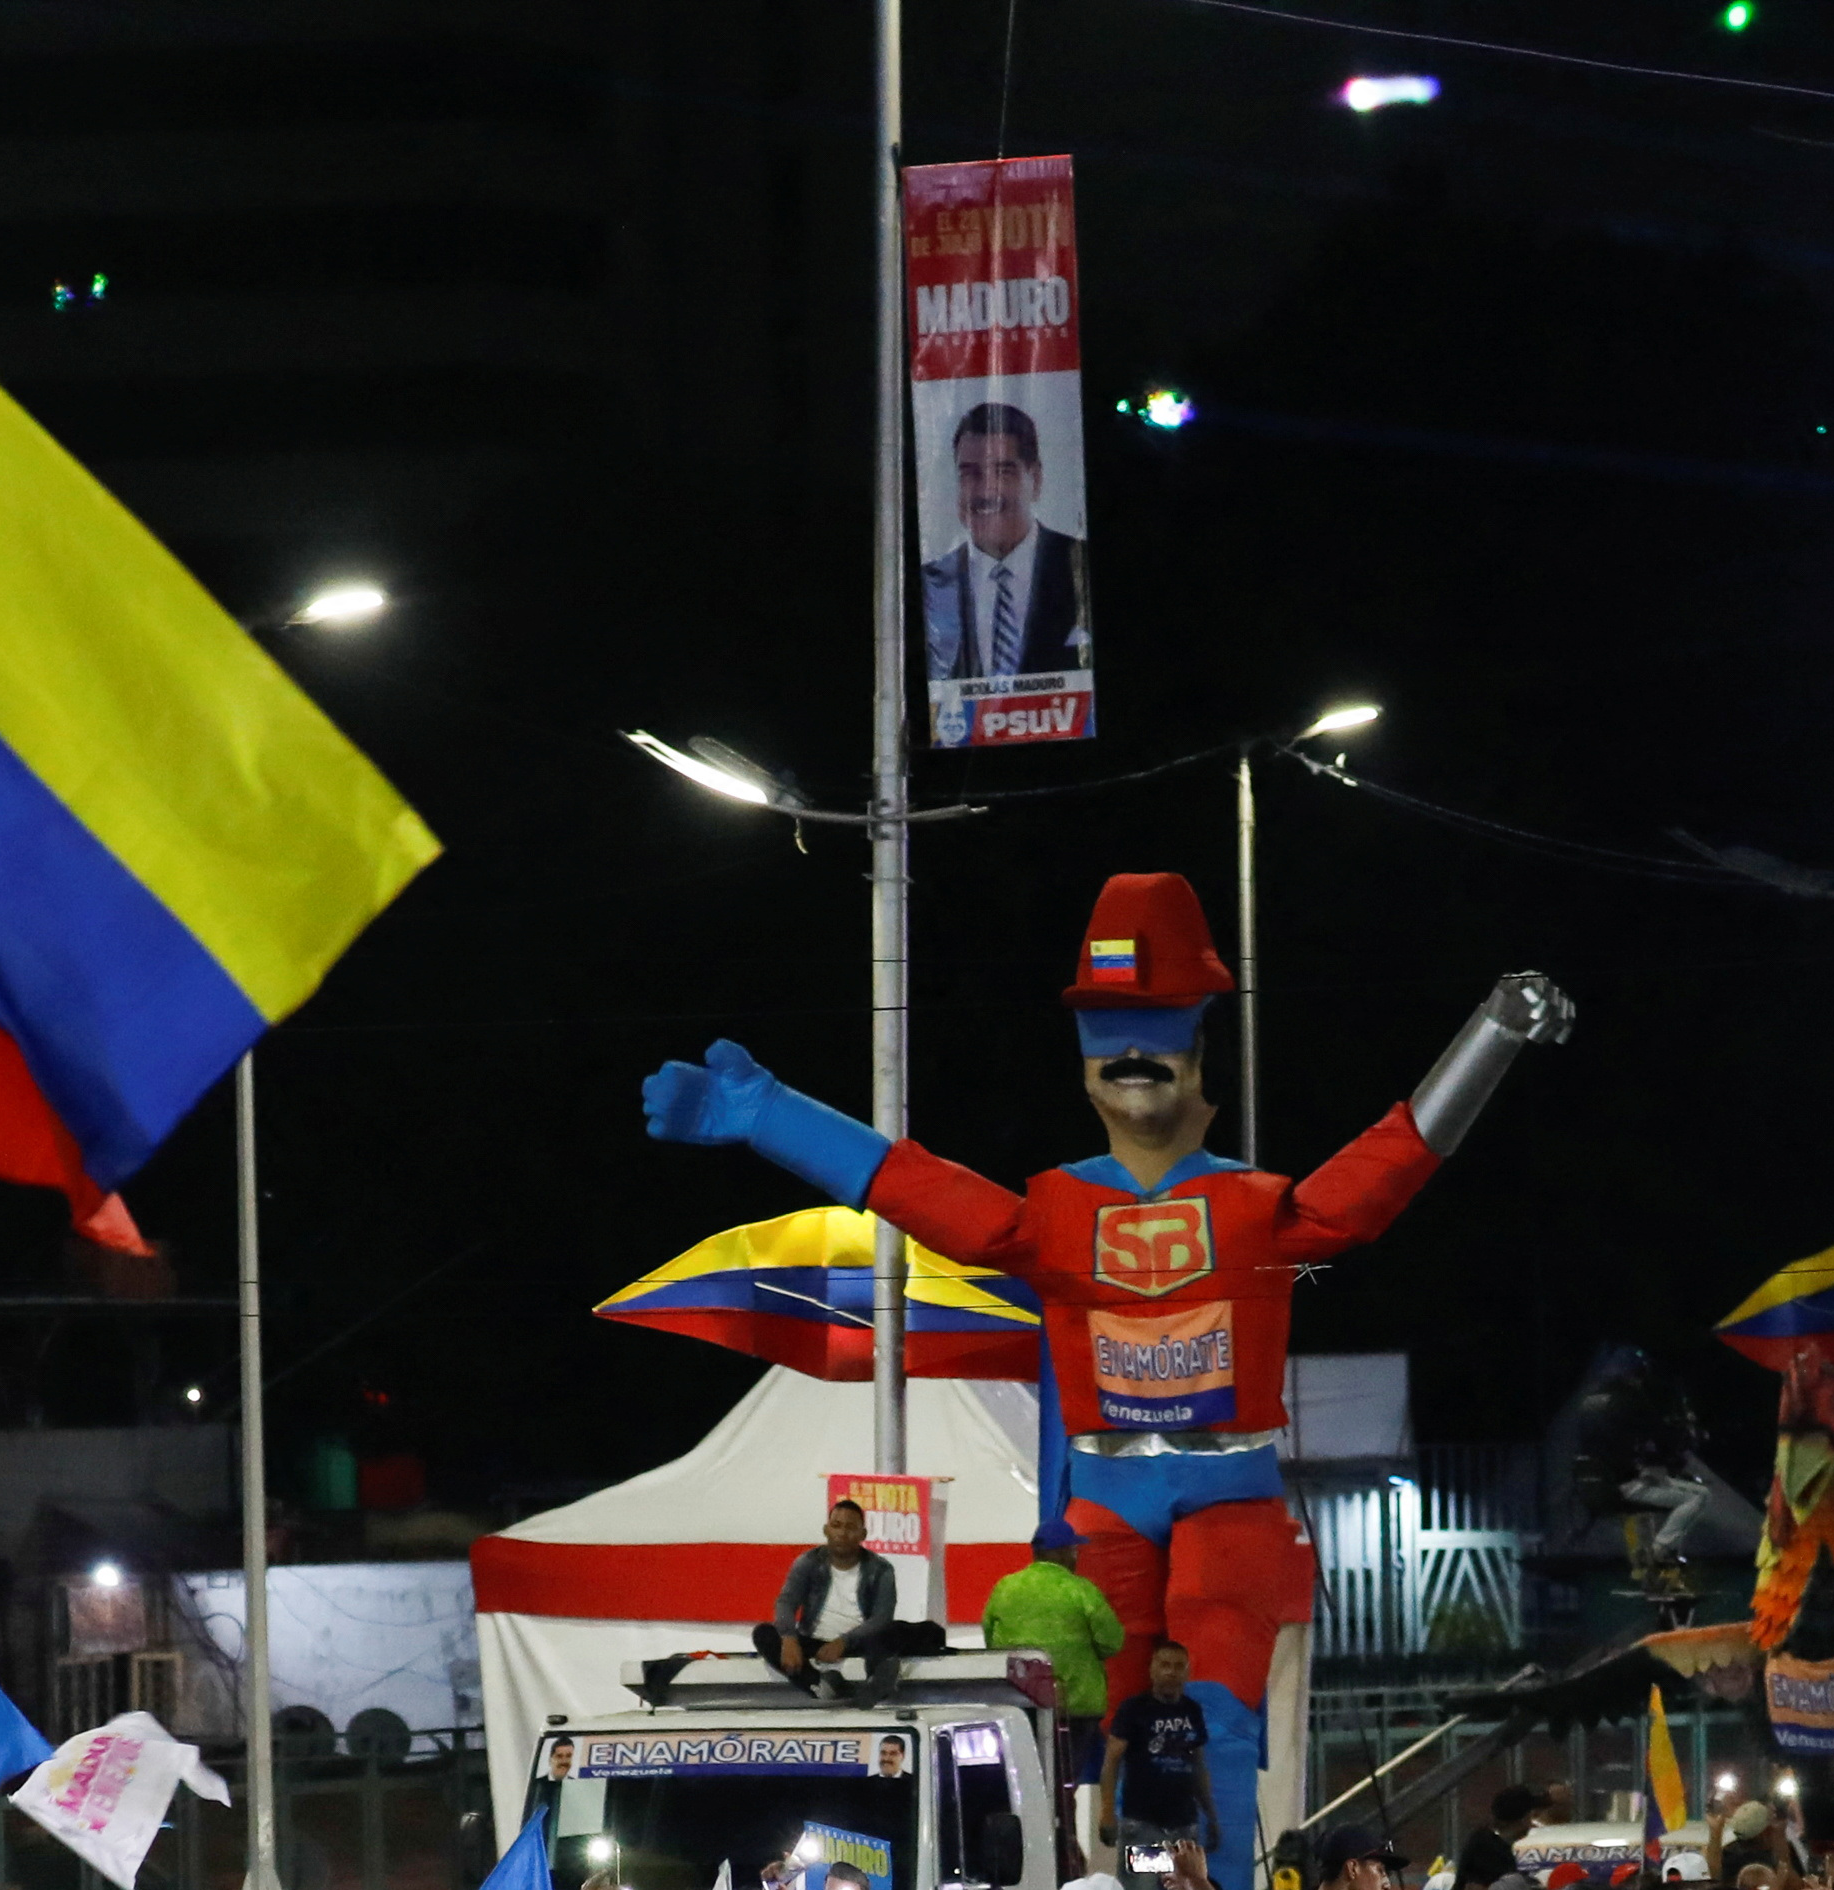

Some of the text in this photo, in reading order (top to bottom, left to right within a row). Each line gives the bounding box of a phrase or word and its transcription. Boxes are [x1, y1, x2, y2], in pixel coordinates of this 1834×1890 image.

[917, 275, 1070, 334] MADURO
[981, 697, 1077, 738] PSUV
[1096, 1328, 1231, 1383] ENAMÓRATE
[587, 1733, 862, 1767] ENAMÓRATE
